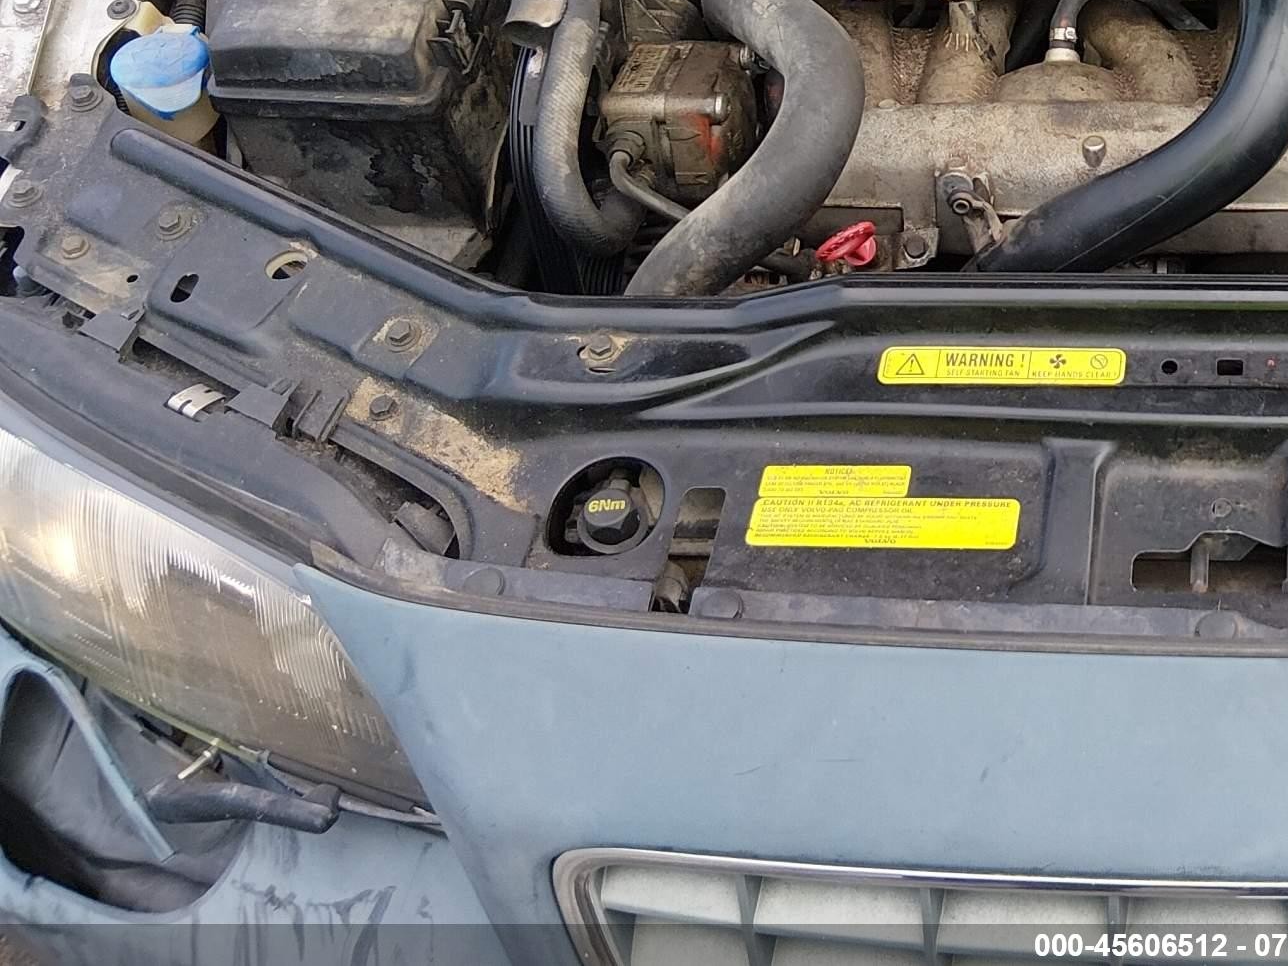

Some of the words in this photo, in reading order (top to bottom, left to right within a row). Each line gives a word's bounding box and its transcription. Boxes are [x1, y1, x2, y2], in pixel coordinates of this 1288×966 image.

[945, 353, 1015, 367] WARNING
[1020, 353, 1026, 368] !
[588, 498, 626, 512] 6Nm
